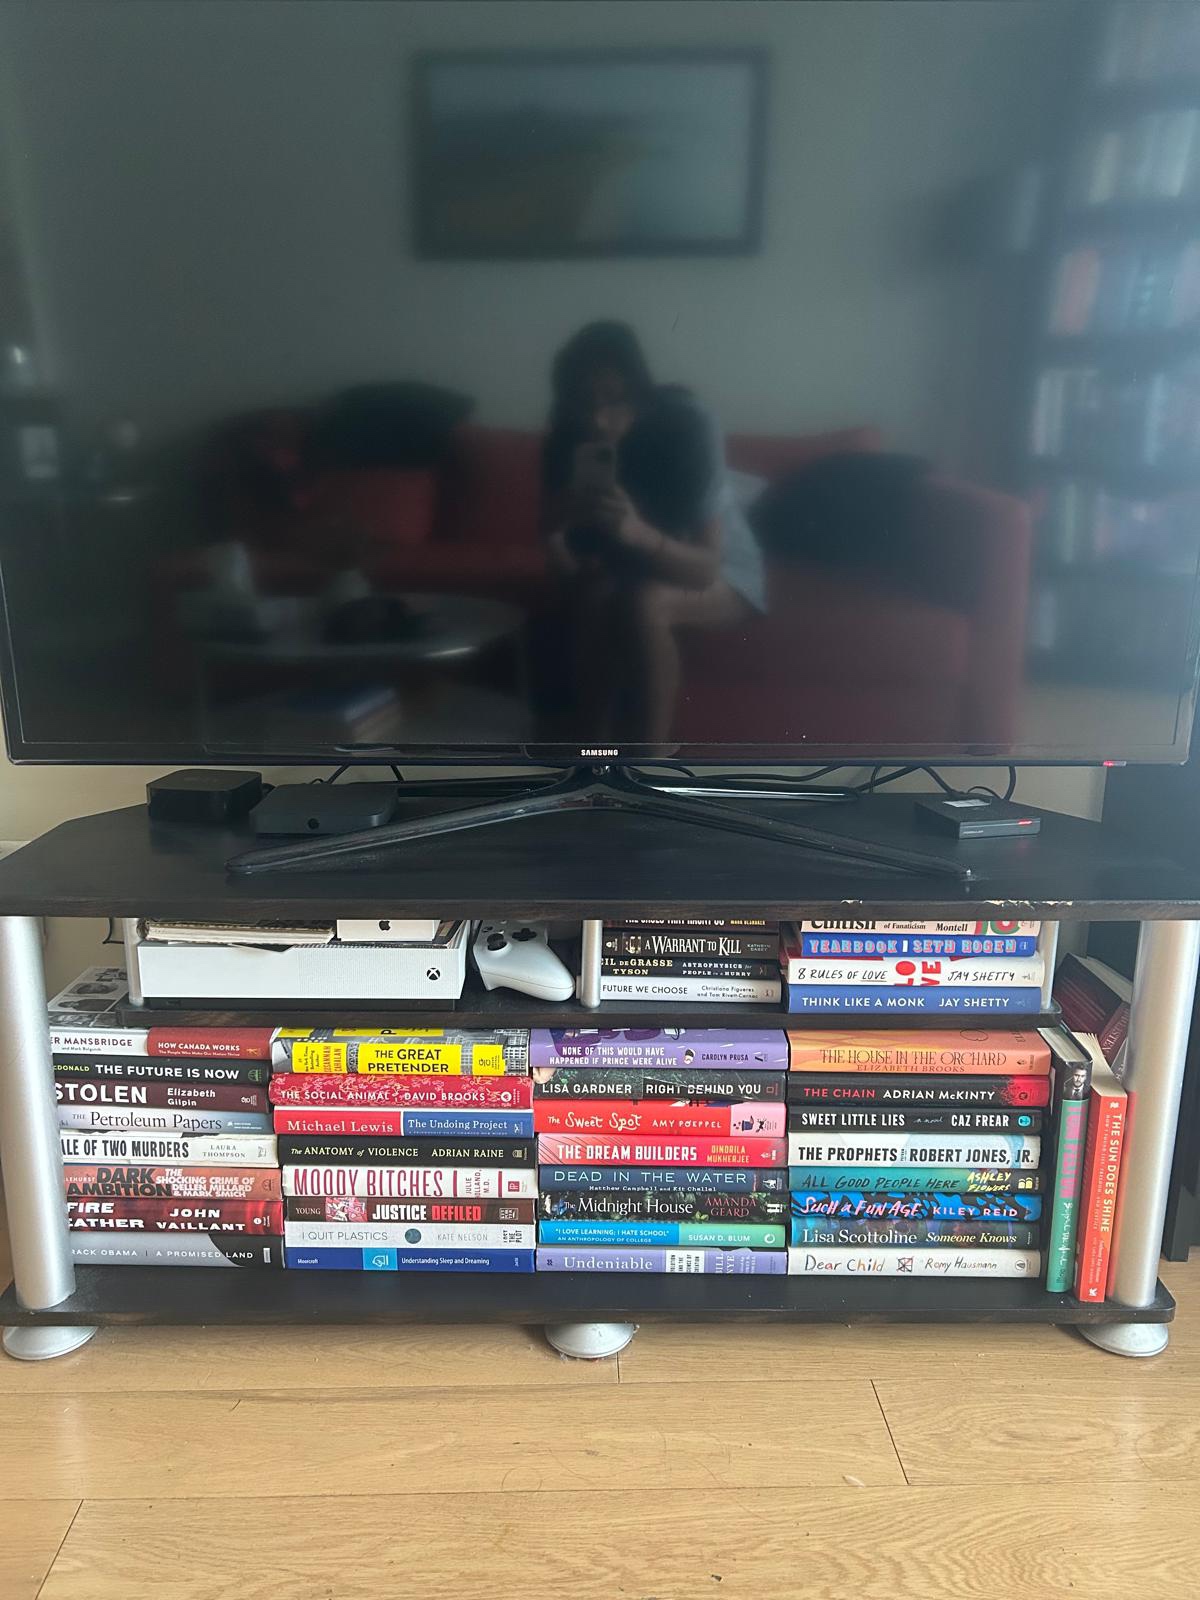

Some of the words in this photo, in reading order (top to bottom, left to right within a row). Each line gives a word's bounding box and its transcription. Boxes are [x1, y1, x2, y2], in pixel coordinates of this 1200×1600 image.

[935, 923, 968, 932] Montell
[644, 940, 651, 950] A
[651, 936, 706, 954] WARRANT
[707, 941, 717, 951] TO
[718, 937, 741, 956] KILL
[809, 939, 898, 953] YEARBOOK
[912, 939, 956, 954] SETH
[961, 939, 1017, 954] ROGEN
[613, 968, 649, 976] TYSON
[798, 968, 806, 980] 8
[810, 969, 843, 979] RULES
[847, 970, 859, 980] OF
[862, 970, 888, 980] LOVE
[947, 971, 969, 982] JAY
[972, 971, 1015, 982] SHETTY
[602, 984, 633, 993] FUTURE
[635, 985, 649, 994] WE
[651, 986, 688, 995] CHOOSE
[63, 1037, 133, 1047] MANSBRIDGE
[375, 1049, 394, 1059] THE
[397, 1048, 442, 1060] GREAT
[562, 1046, 582, 1056] NONE
[585, 1046, 594, 1056] OF
[598, 1047, 614, 1056] THIS
[617, 1047, 642, 1056] WOULD
[645, 1047, 665, 1056] HAVE
[549, 1056, 589, 1065] HAPPENED
[592, 1057, 599, 1065] IF
[602, 1057, 629, 1065] PRINCE
[632, 1057, 653, 1065] WERE
[656, 1057, 677, 1066] ALIVE
[701, 1053, 728, 1061] CAROLYN
[729, 1053, 749, 1061] PRUSA
[820, 1049, 846, 1063] THE
[848, 1050, 893, 1064] HOUSE
[896, 1051, 908, 1065] IN
[911, 1051, 937, 1065] THE
[940, 1051, 1007, 1066] ORCHARD
[95, 1064, 123, 1075] THE
[127, 1065, 183, 1077] FUTURE
[187, 1068, 200, 1078] IS
[204, 1069, 240, 1080] NOW
[367, 1062, 449, 1073] PRETENDER
[857, 1064, 918, 1072] ELIZABETH
[922, 1065, 965, 1073] BROOKS
[54, 1082, 147, 1104] STOLEN
[167, 1087, 216, 1098] Elizabeth
[542, 1084, 569, 1094] LISA
[573, 1084, 632, 1094] GARDNER
[646, 1084, 680, 1094] RIGHT
[687, 1084, 734, 1094] BEHIND
[738, 1084, 761, 1094] YOU
[803, 1087, 829, 1097] THE
[832, 1088, 876, 1098] CHAIN
[883, 1089, 934, 1099] ADRIAN
[938, 1090, 995, 1100] McKINTY
[281, 1090, 300, 1099] THE
[304, 1091, 343, 1099] SOCIAL
[347, 1091, 390, 1100] ANIMAL
[404, 1092, 437, 1100] DAVID
[441, 1092, 485, 1101] BROOKS
[167, 1098, 197, 1107] Gilpin
[90, 1111, 166, 1128] Petroleum
[173, 1114, 222, 1131] Papers
[408, 1119, 427, 1128] The
[429, 1119, 471, 1130] Undoing
[472, 1120, 508, 1130] Project
[652, 1119, 674, 1128] AMY
[678, 1119, 722, 1128] POEPPEL
[802, 1113, 837, 1126] SWEET
[841, 1113, 877, 1126] LITTLE
[881, 1114, 905, 1126] LIES
[951, 1114, 971, 1127] CAZ
[975, 1115, 1010, 1127] FREAR
[1110, 1113, 1122, 1136] THE
[287, 1120, 345, 1132] Michael
[351, 1121, 394, 1132] Lewis
[83, 1139, 97, 1156] OF
[101, 1139, 127, 1157] TWO
[131, 1140, 189, 1158] MURDERS
[304, 1146, 354, 1156] ANATOMY
[356, 1149, 364, 1157] of
[368, 1147, 419, 1157] VIOLENCE
[431, 1148, 470, 1158] ADRIAN
[473, 1149, 504, 1158] RAINE
[798, 1146, 823, 1160] THE
[827, 1147, 898, 1161] PROPHETS
[1108, 1141, 1119, 1161] SUN
[909, 1148, 962, 1162] ROBERT
[966, 1149, 1010, 1165] JONES,
[1015, 1149, 1034, 1163] JR.
[96, 1167, 156, 1184] DARK
[165, 1168, 183, 1177] THE
[155, 1175, 208, 1185] SHOCKING
[209, 1176, 240, 1185] CRIME
[241, 1177, 256, 1185] OF
[294, 1168, 359, 1196] MOODY
[366, 1169, 443, 1197] BITCHES
[1104, 1164, 1118, 1195] DOES
[67, 1182, 173, 1196] AMBITION
[171, 1183, 207, 1191] DELLEN
[209, 1184, 252, 1192] MILLARD
[967, 1183, 1011, 1192] FLOWERS
[564, 1201, 576, 1209] The
[578, 1197, 642, 1216] Midnight
[647, 1198, 694, 1214] House
[704, 1197, 756, 1207] AMANDA
[169, 1208, 220, 1218] JOHN
[295, 1207, 321, 1215] YOUNG
[372, 1204, 427, 1220] JUSTICE
[431, 1205, 481, 1221] DEFILED
[710, 1207, 750, 1217] GEARD
[933, 1206, 976, 1216] KILEY
[983, 1207, 1018, 1217] REID
[1100, 1199, 1113, 1233] SHINE
[156, 1221, 246, 1231] VAILLANT
[308, 1231, 335, 1241] QUIT
[337, 1231, 388, 1241] PLASTICS
[437, 1233, 456, 1241] KATE
[458, 1233, 488, 1241] NELSON
[803, 1229, 834, 1243] Lisa
[838, 1229, 917, 1244] Scottoline
[926, 1231, 976, 1243] Someone
[979, 1232, 1017, 1243] Knows
[167, 1250, 221, 1258] PROMISED
[226, 1251, 254, 1260] LAND
[401, 1257, 439, 1266] Understanding
[439, 1257, 453, 1266] Sleep
[464, 1257, 490, 1266] Dreaming
[564, 1256, 653, 1270] Undeniable
[804, 1254, 841, 1271] Dear
[846, 1257, 886, 1272] Child
